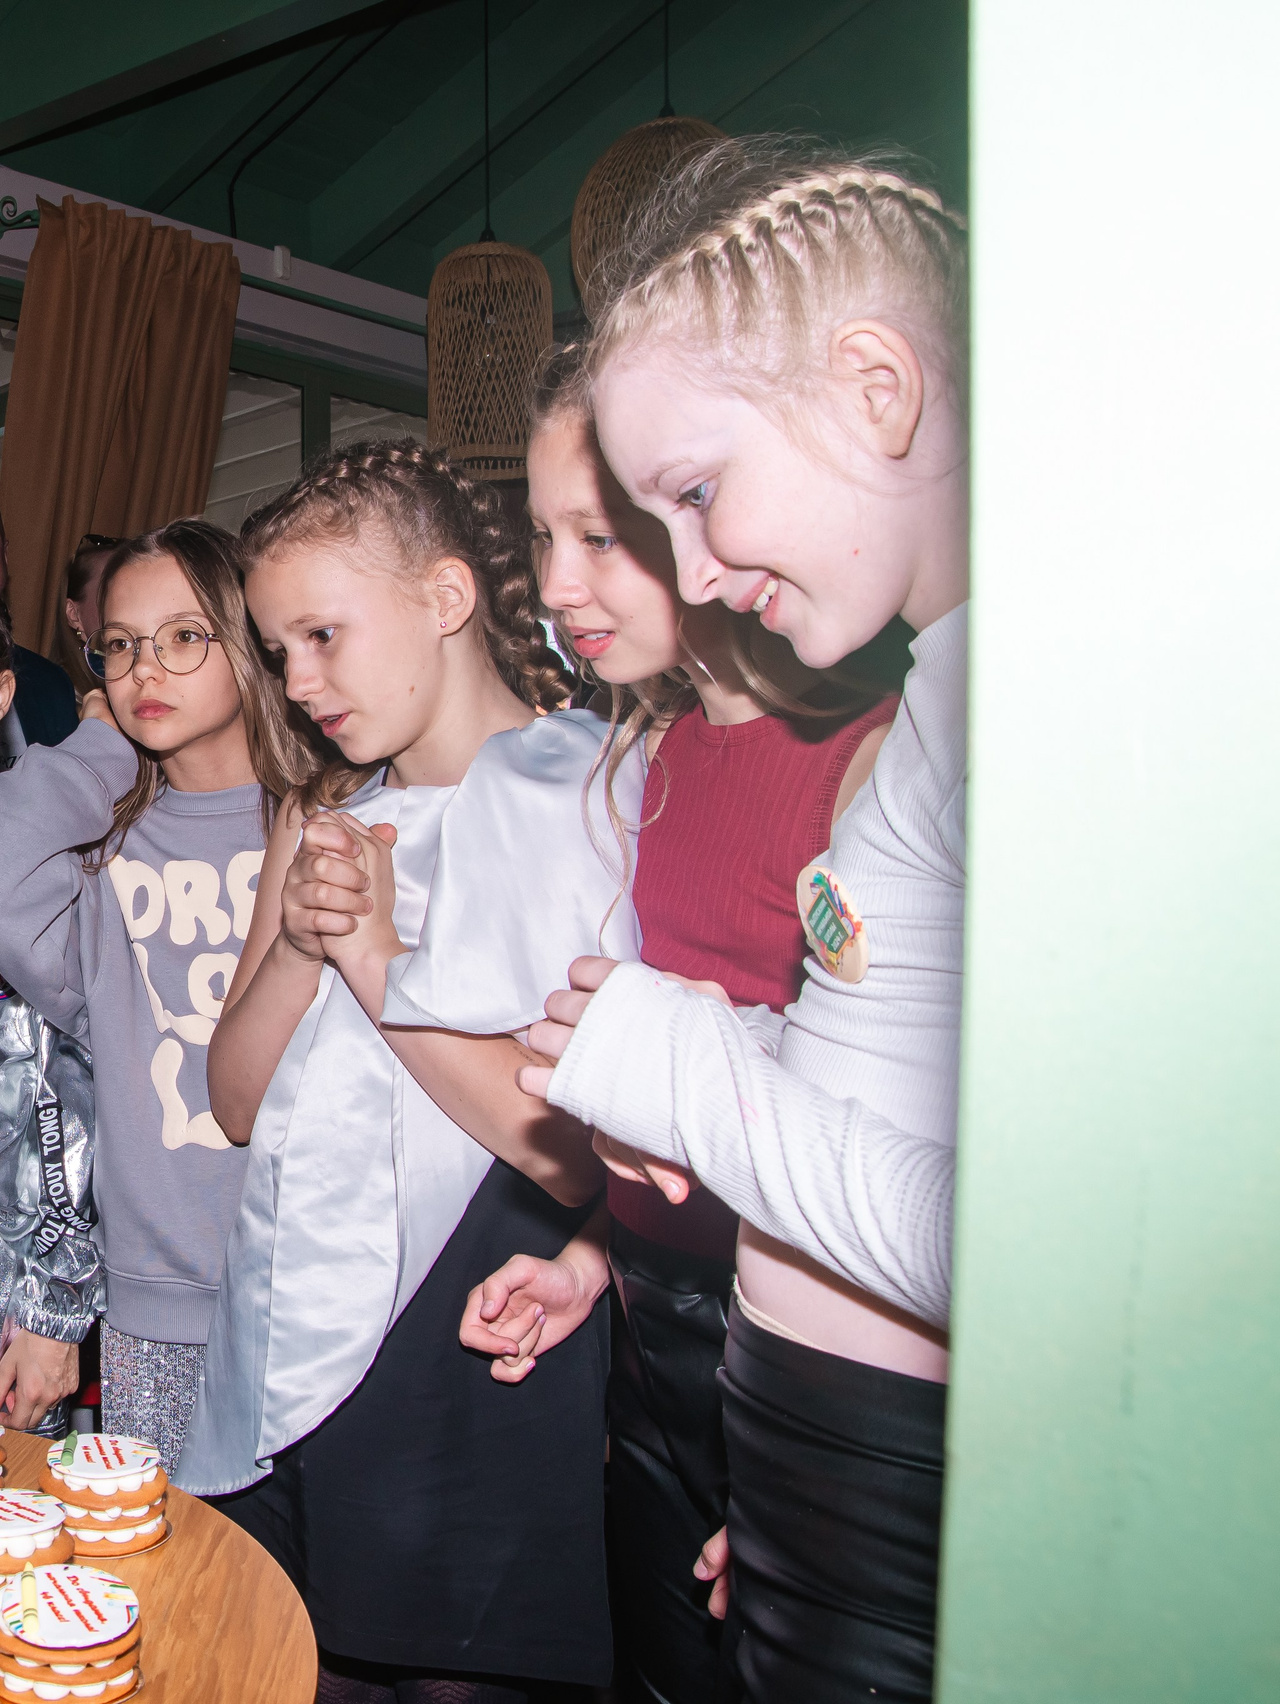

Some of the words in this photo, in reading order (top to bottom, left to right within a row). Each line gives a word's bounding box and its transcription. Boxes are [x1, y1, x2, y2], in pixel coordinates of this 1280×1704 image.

[38, 1107, 61, 1156] TONG
[45, 1162, 68, 1208] TOUY
[60, 1206, 93, 1233] ONG
